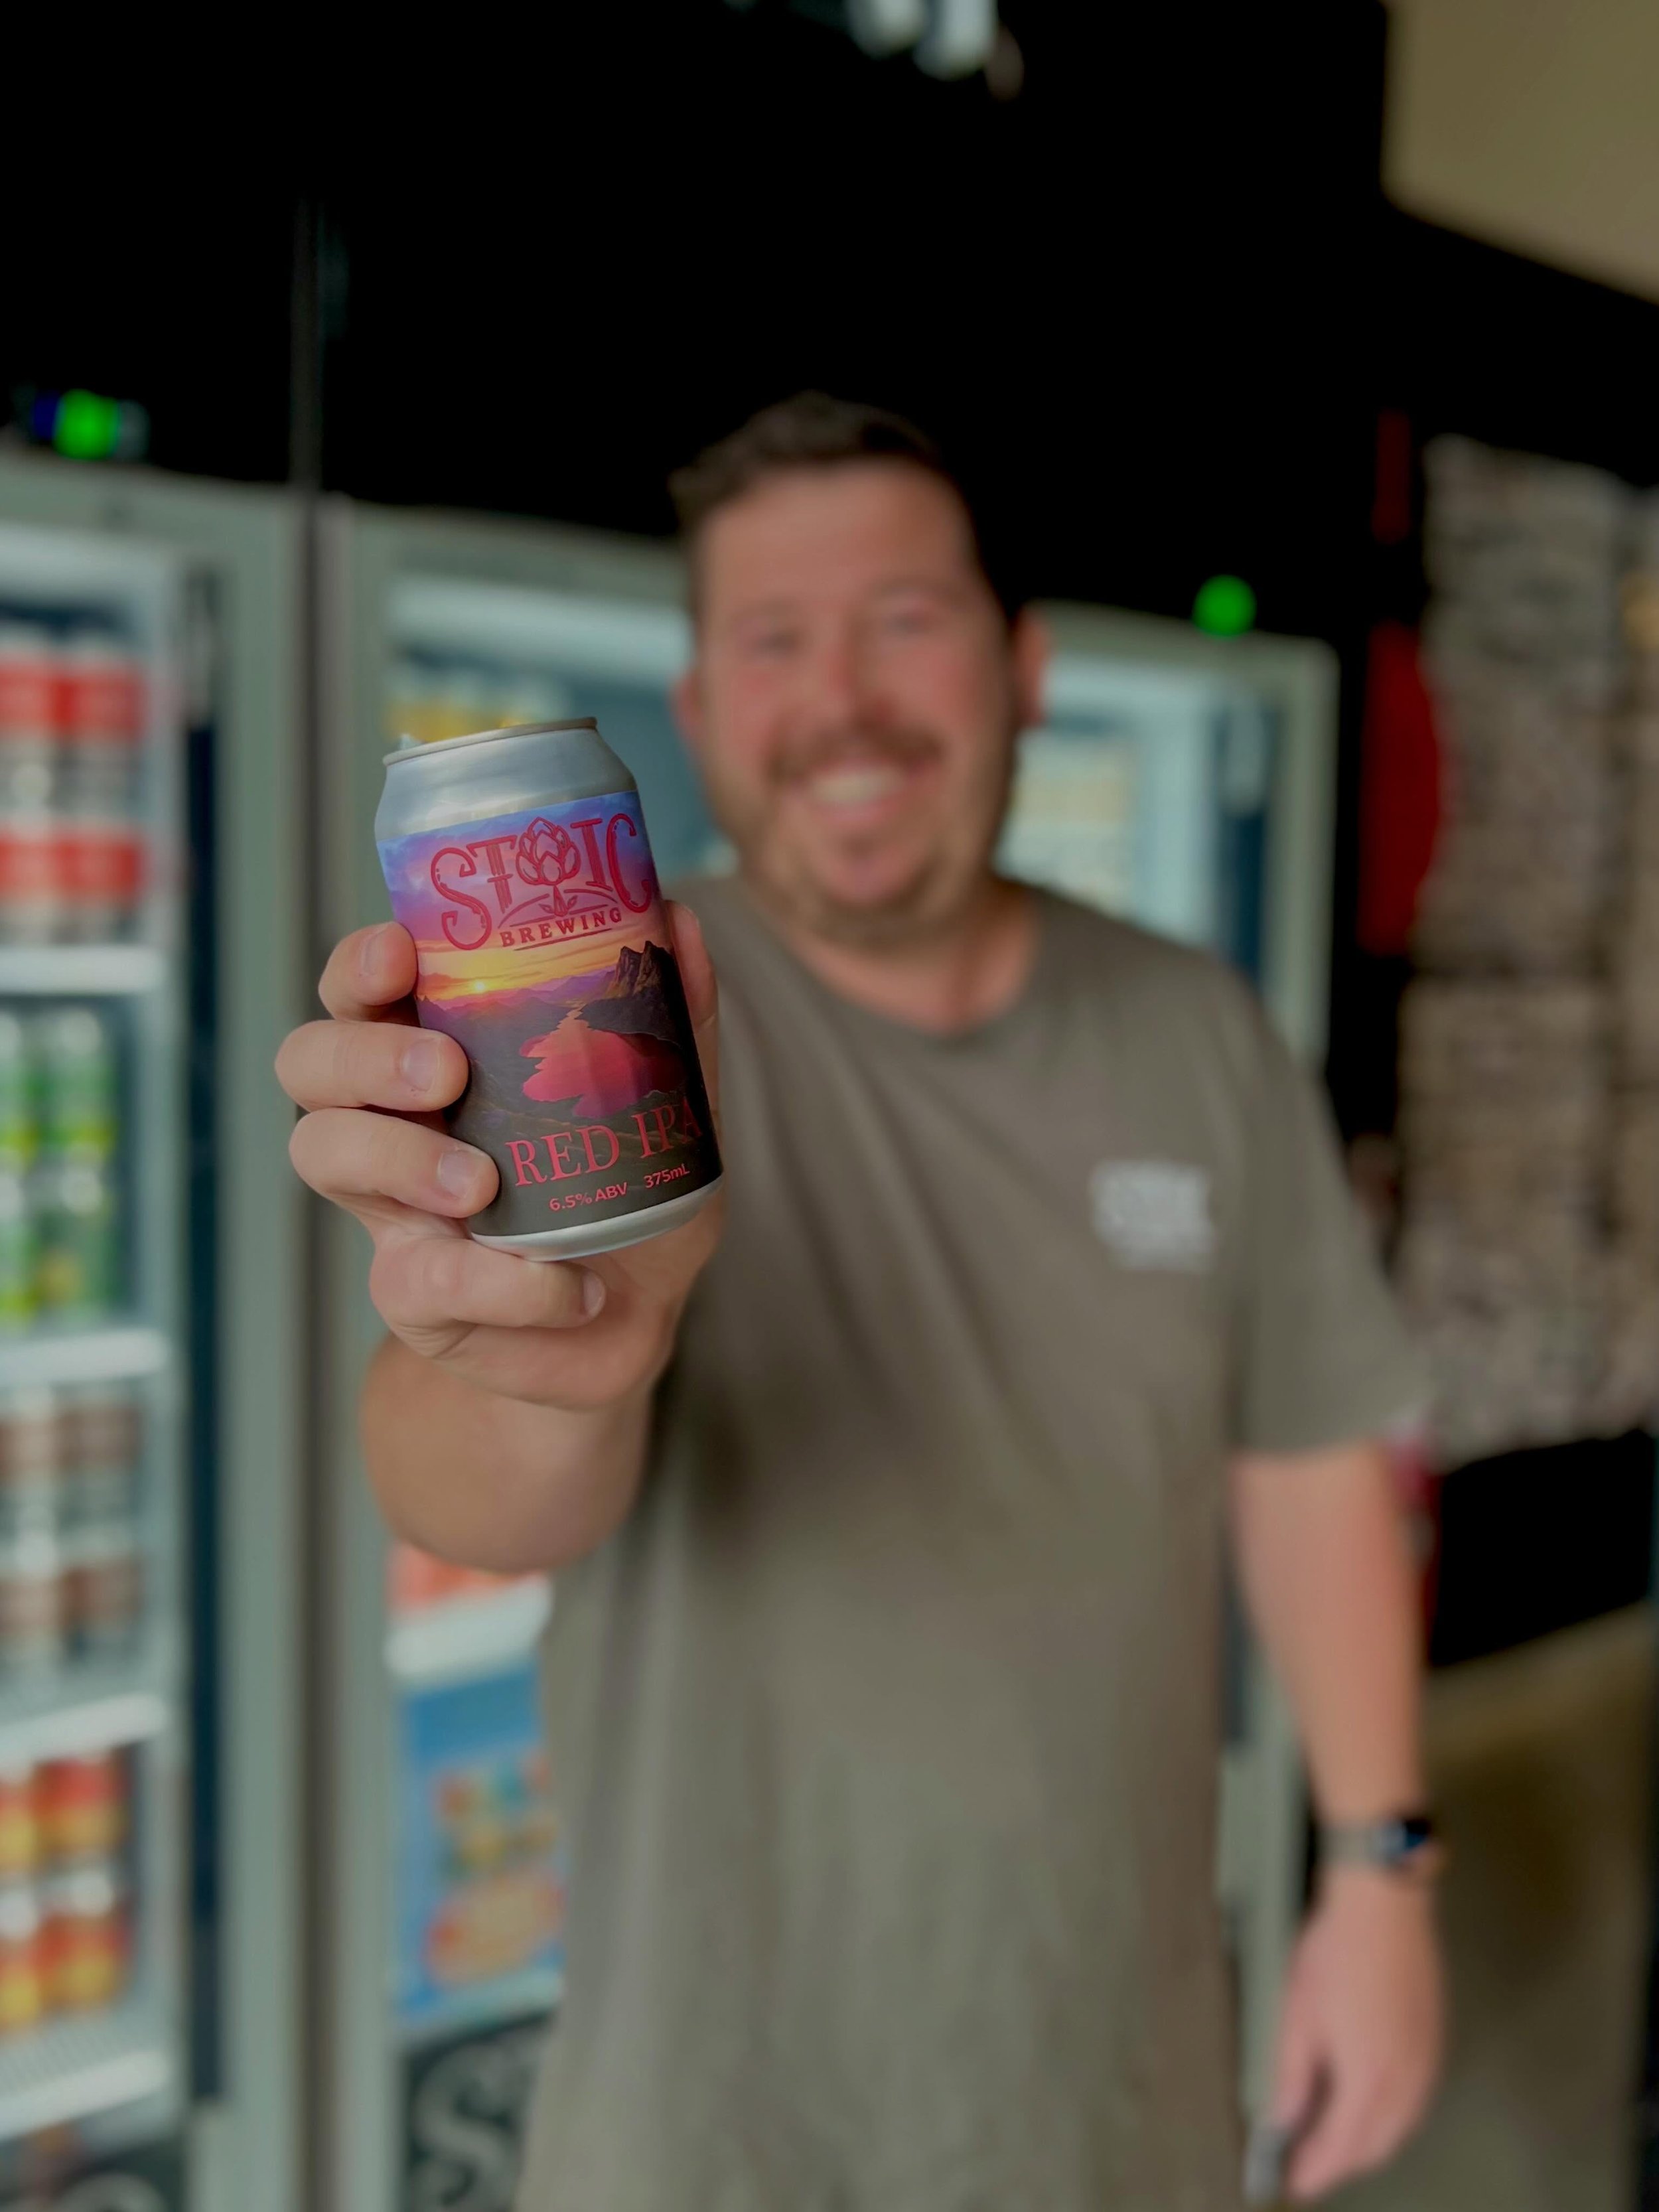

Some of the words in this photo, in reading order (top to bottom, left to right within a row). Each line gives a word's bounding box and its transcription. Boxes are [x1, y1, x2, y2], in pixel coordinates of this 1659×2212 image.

[431, 813, 651, 950] STOIC
[500, 907, 622, 948] BREWING
[505, 1124, 620, 1187] RED
[630, 1095, 703, 1159] IPA
[549, 1193, 591, 1211] 6.5%
[595, 1182, 628, 1202] ABV
[643, 1163, 690, 1189] 375mL
